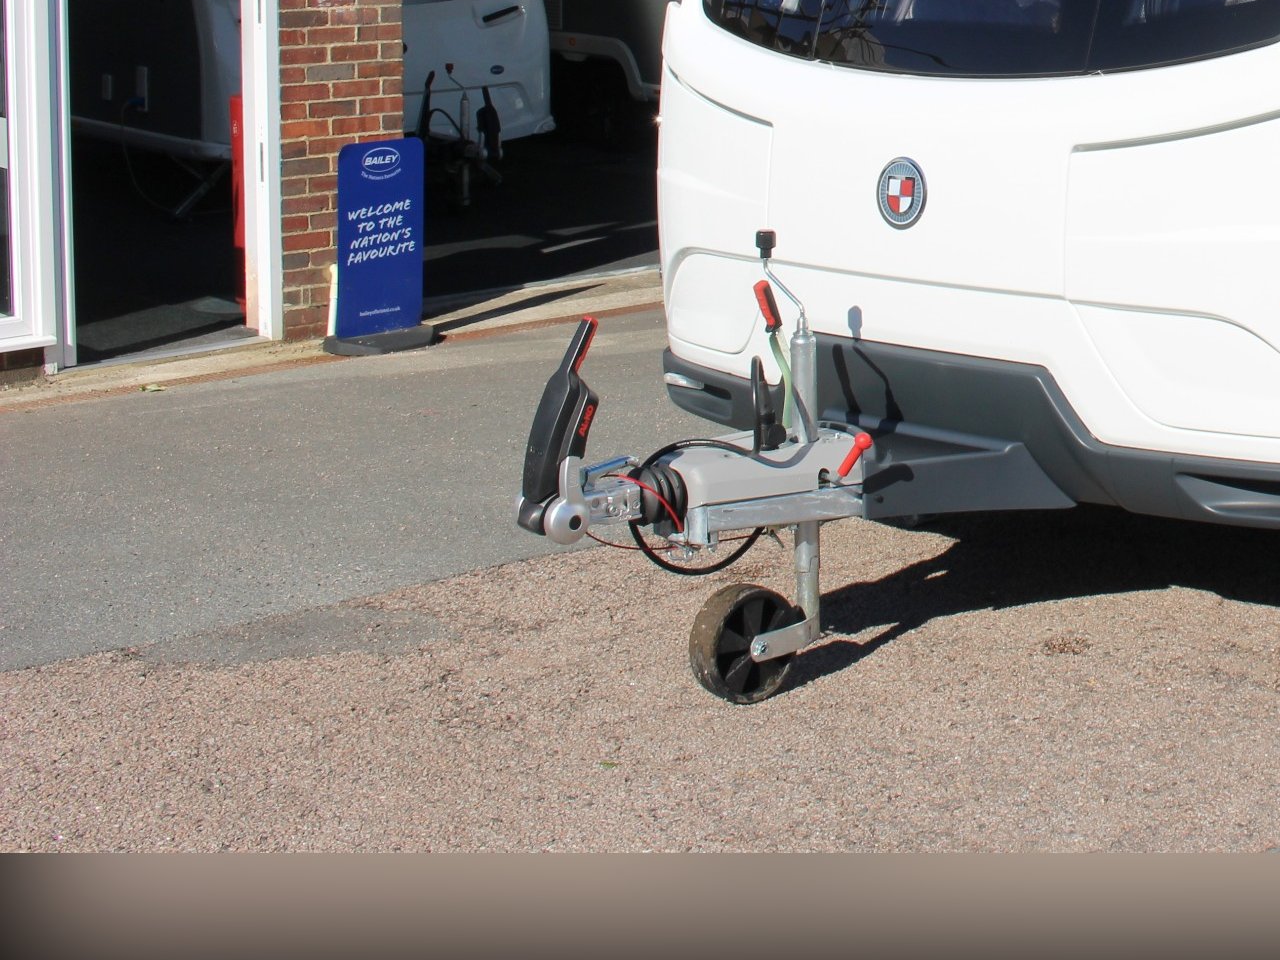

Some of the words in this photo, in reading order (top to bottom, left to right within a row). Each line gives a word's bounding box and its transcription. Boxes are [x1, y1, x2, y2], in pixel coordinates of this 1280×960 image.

[364, 154, 399, 166] BAILEY
[347, 198, 412, 221] WELCOME
[357, 221, 376, 234] TO
[378, 214, 404, 230] THE
[350, 227, 412, 250] NATION'S
[346, 240, 416, 267] FAVOURITE
